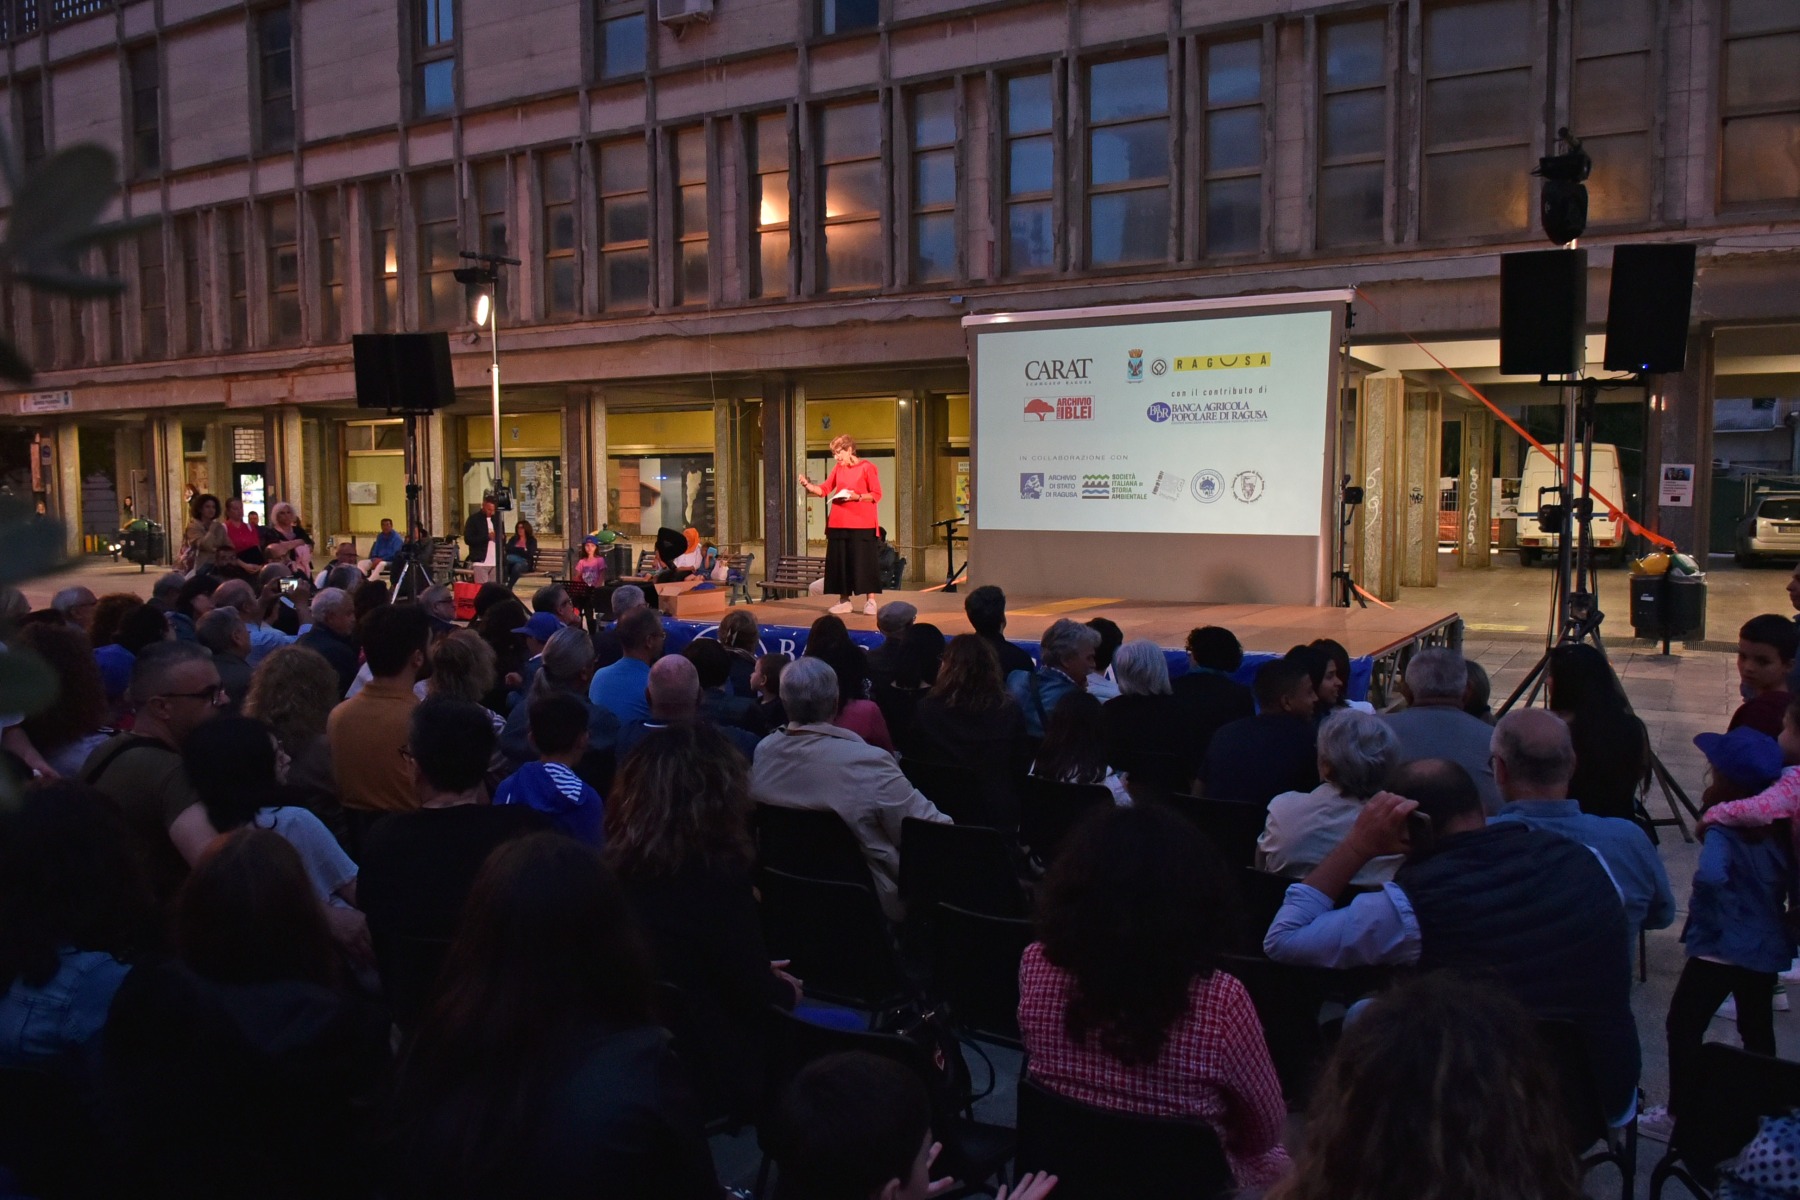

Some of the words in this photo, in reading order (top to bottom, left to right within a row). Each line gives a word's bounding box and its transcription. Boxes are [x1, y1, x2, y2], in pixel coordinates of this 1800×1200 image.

[1176, 354, 1267, 369] RAGUSA
[1025, 358, 1093, 380] CARAT
[1191, 388, 1198, 396] il
[1203, 387, 1253, 396] contributo
[1259, 385, 1267, 394] di
[1057, 397, 1092, 406] ARCHIVIO
[1171, 402, 1202, 413] BANCA
[1203, 401, 1249, 411] AGRICOLA
[1060, 406, 1092, 419] IBLEI
[1171, 412, 1217, 422] POPOLARE
[1219, 411, 1229, 420] DI
[1231, 410, 1268, 420] RAGUSA
[1111, 472, 1136, 480] SOCIETÀ
